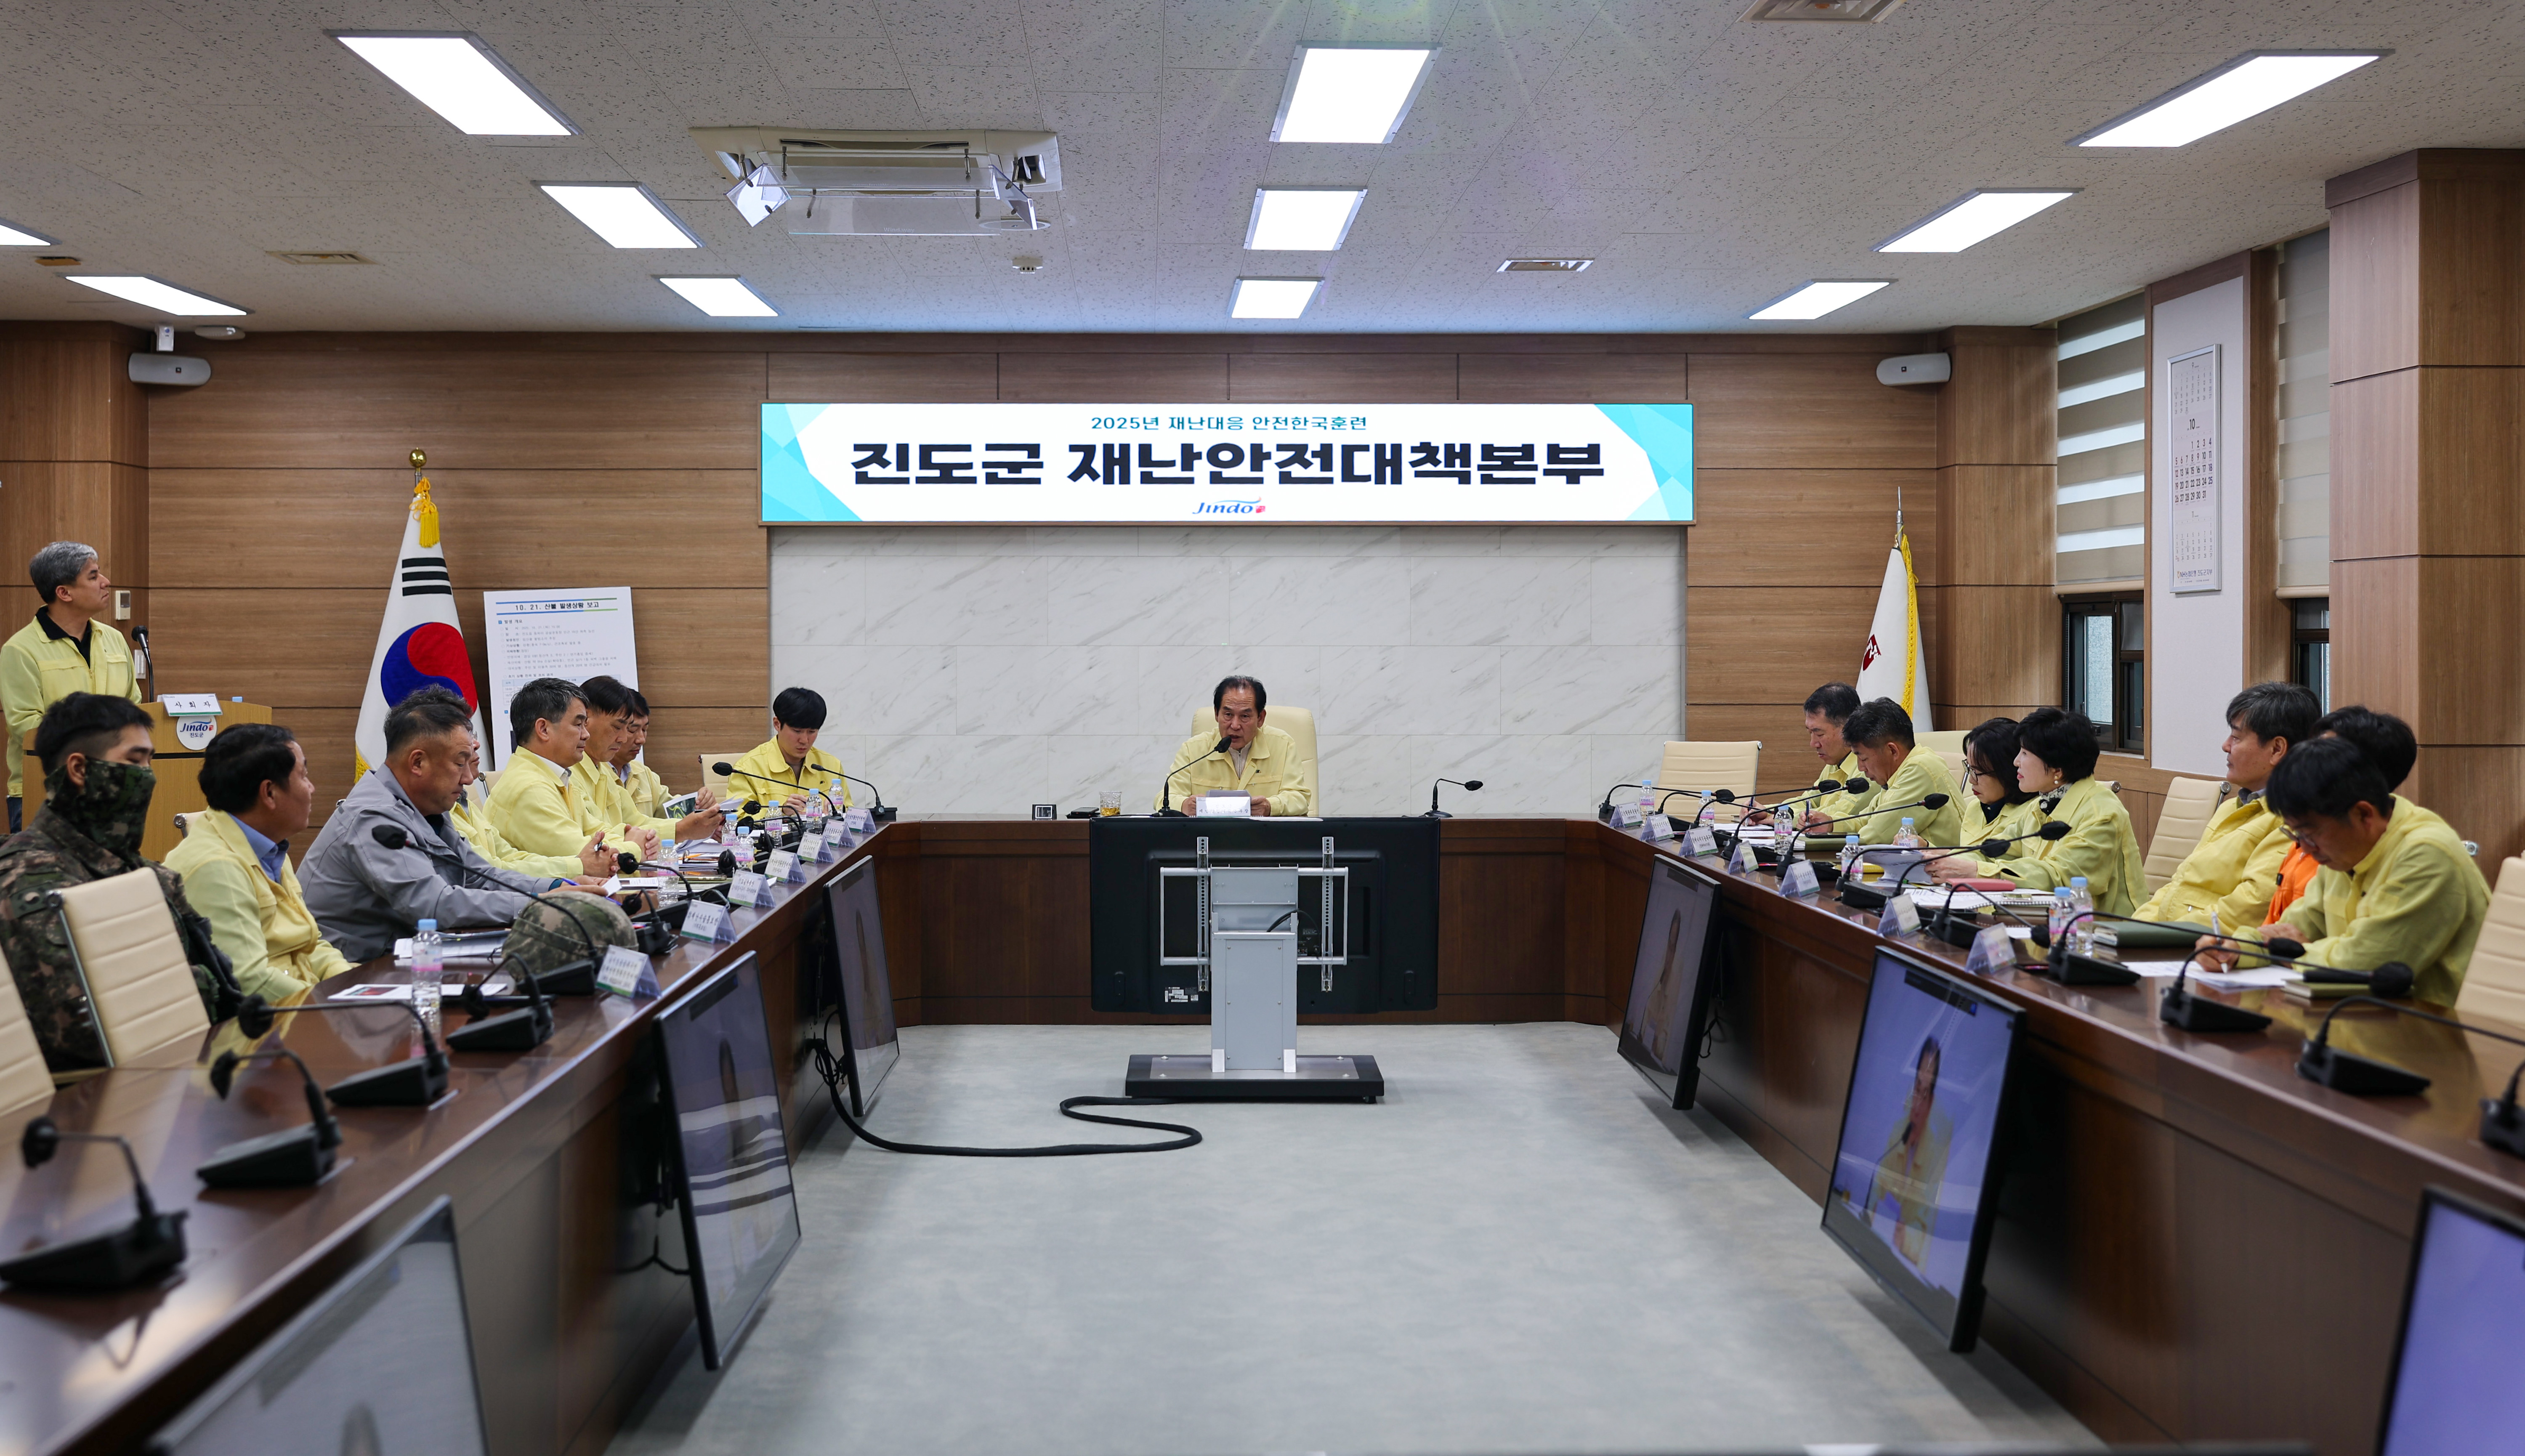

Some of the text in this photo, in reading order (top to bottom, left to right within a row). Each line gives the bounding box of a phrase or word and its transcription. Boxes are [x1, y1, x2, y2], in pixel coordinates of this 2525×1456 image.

[1091, 417, 1366, 430] 2025년 재난대응 안전한국훈련
[2190, 419, 2195, 430] 10
[852, 442, 1603, 485] 진도군 재난안전대책본부
[1192, 502, 1253, 514] Jindo
[180, 723, 208, 732] Jindo
